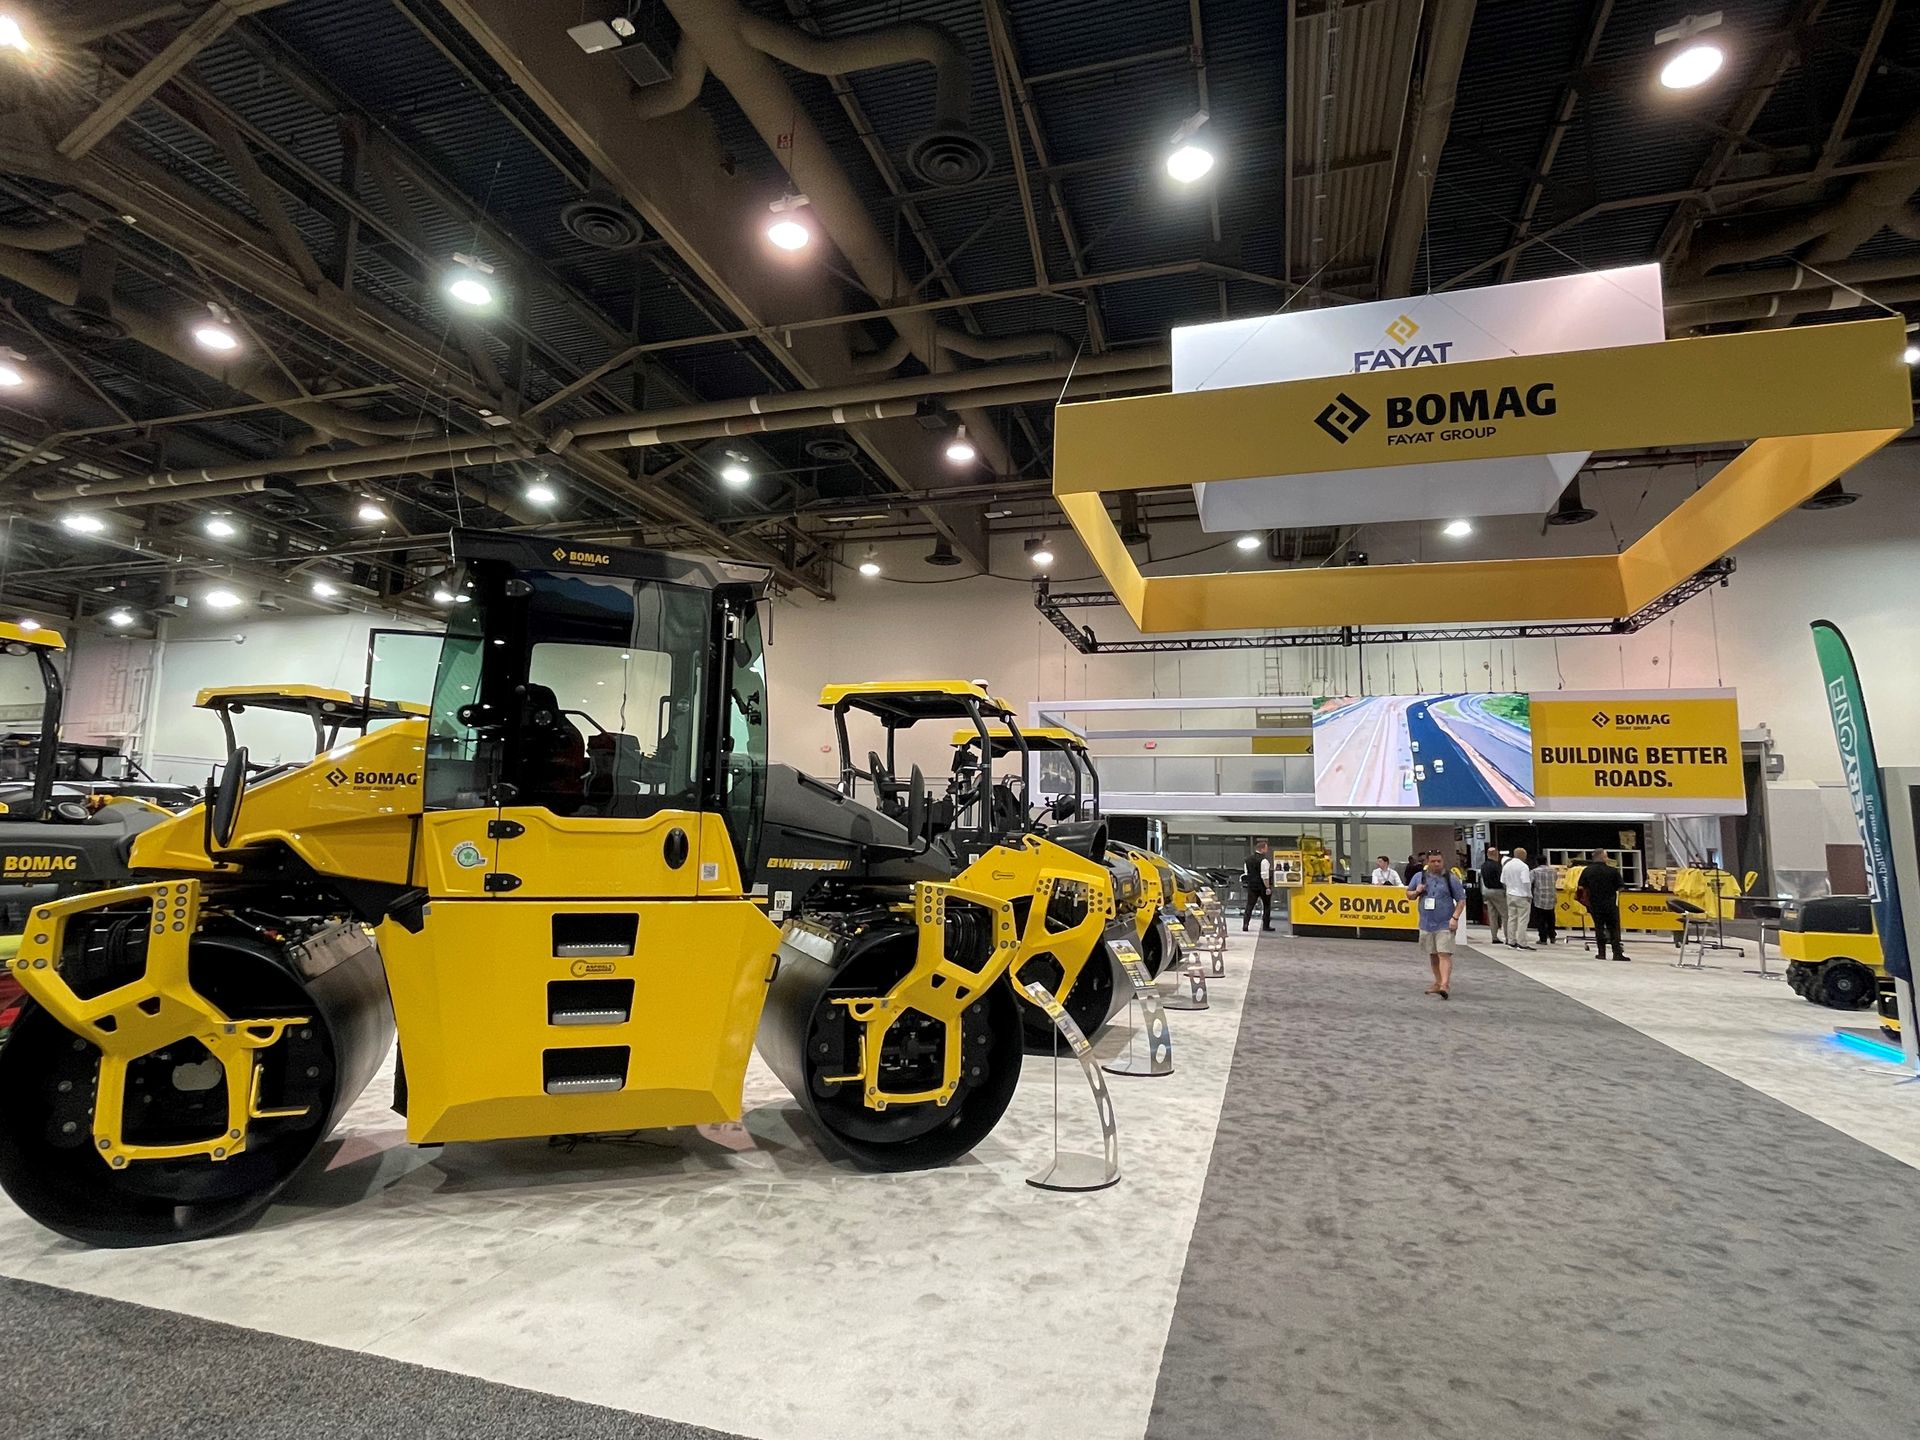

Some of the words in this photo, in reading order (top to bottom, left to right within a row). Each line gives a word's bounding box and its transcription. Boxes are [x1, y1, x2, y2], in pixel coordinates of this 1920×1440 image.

[1354, 341, 1453, 373] FAYAT
[1386, 382, 1557, 429] BOMAG
[1387, 431, 1434, 446] FAYAT
[1440, 426, 1497, 441] GROUP
[570, 551, 609, 564] BOMAG
[1615, 714, 1671, 725] BOMAG
[1541, 746, 1639, 764] BUILDING
[1646, 746, 1728, 764] BETTER
[353, 771, 418, 786] BOMAG
[1594, 769, 1673, 788] ROADS.
[4, 855, 77, 871] BOMAG
[766, 857, 792, 868] BW
[792, 861, 814, 870] 174
[1339, 897, 1410, 914] BOMAG
